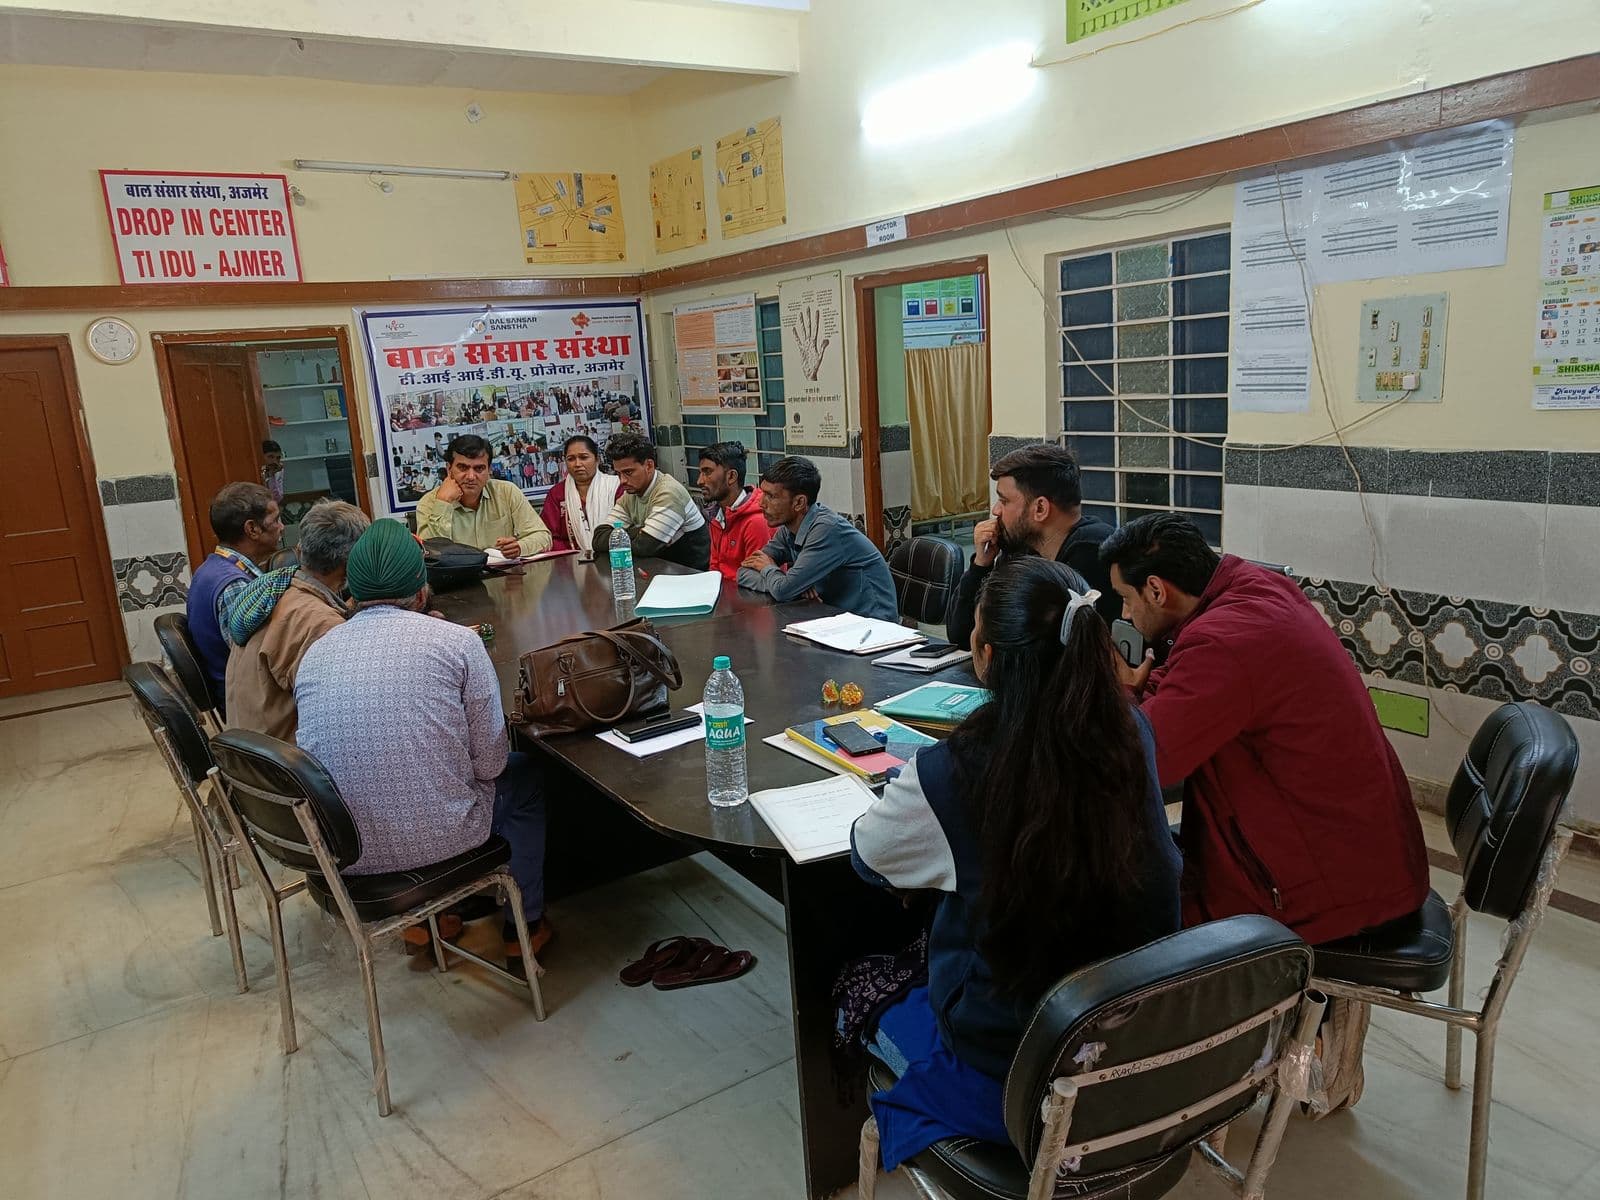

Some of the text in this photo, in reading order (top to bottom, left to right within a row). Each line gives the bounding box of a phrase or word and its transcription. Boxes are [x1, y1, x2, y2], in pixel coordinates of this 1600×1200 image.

[124, 181, 269, 202] बाल संसार संस्था, अजमेर
[116, 207, 286, 237] DROP IN CENTER
[875, 220, 897, 232] DOCTOR
[879, 233, 895, 242] ROOM
[132, 250, 155, 278] TI
[160, 250, 196, 278] IDU
[219, 250, 286, 277] AJMER
[490, 323, 528, 331] SANSTHA
[383, 330, 631, 369] बाल संसार संस्था
[585, 358, 626, 373] अजमेर
[709, 726, 741, 739] AQUA
